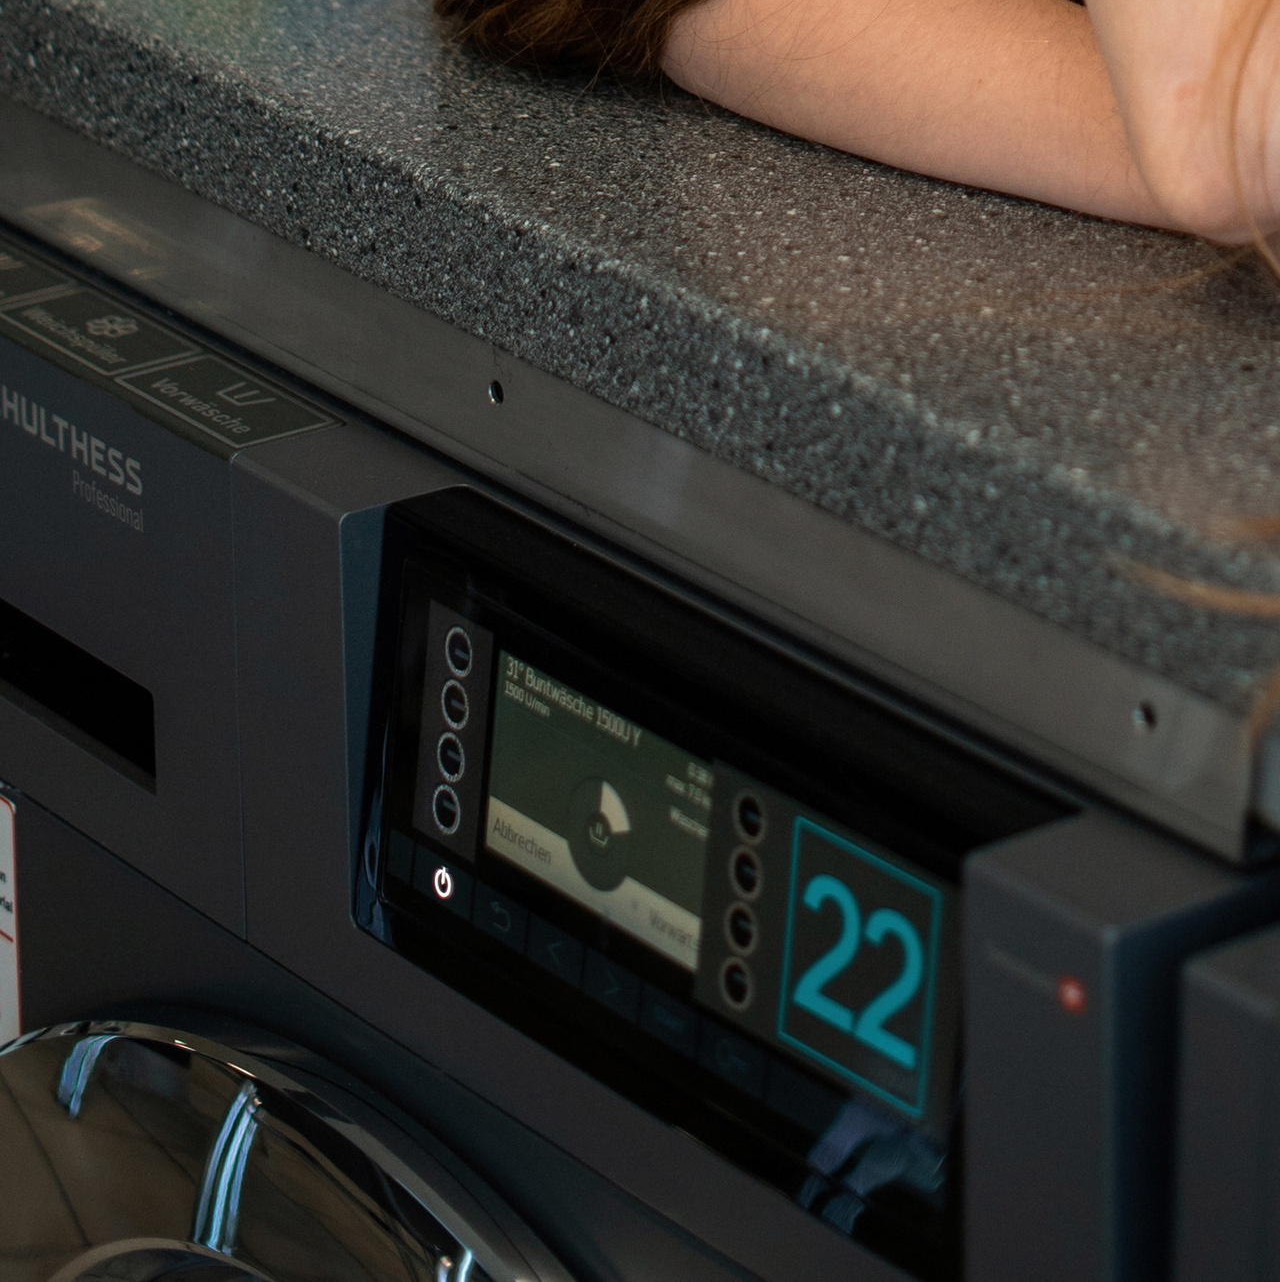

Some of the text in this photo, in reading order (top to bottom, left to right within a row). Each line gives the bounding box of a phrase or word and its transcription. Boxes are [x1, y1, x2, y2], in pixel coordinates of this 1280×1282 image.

[151, 377, 251, 435] Vorwäsche
[0, 384, 144, 497] HULTHESS
[72, 469, 144, 533] Professional
[525, 666, 595, 722] Buntwäsche
[525, 692, 551, 718] U/min
[492, 816, 553, 866] Abbrechen
[793, 873, 924, 1070] 22
